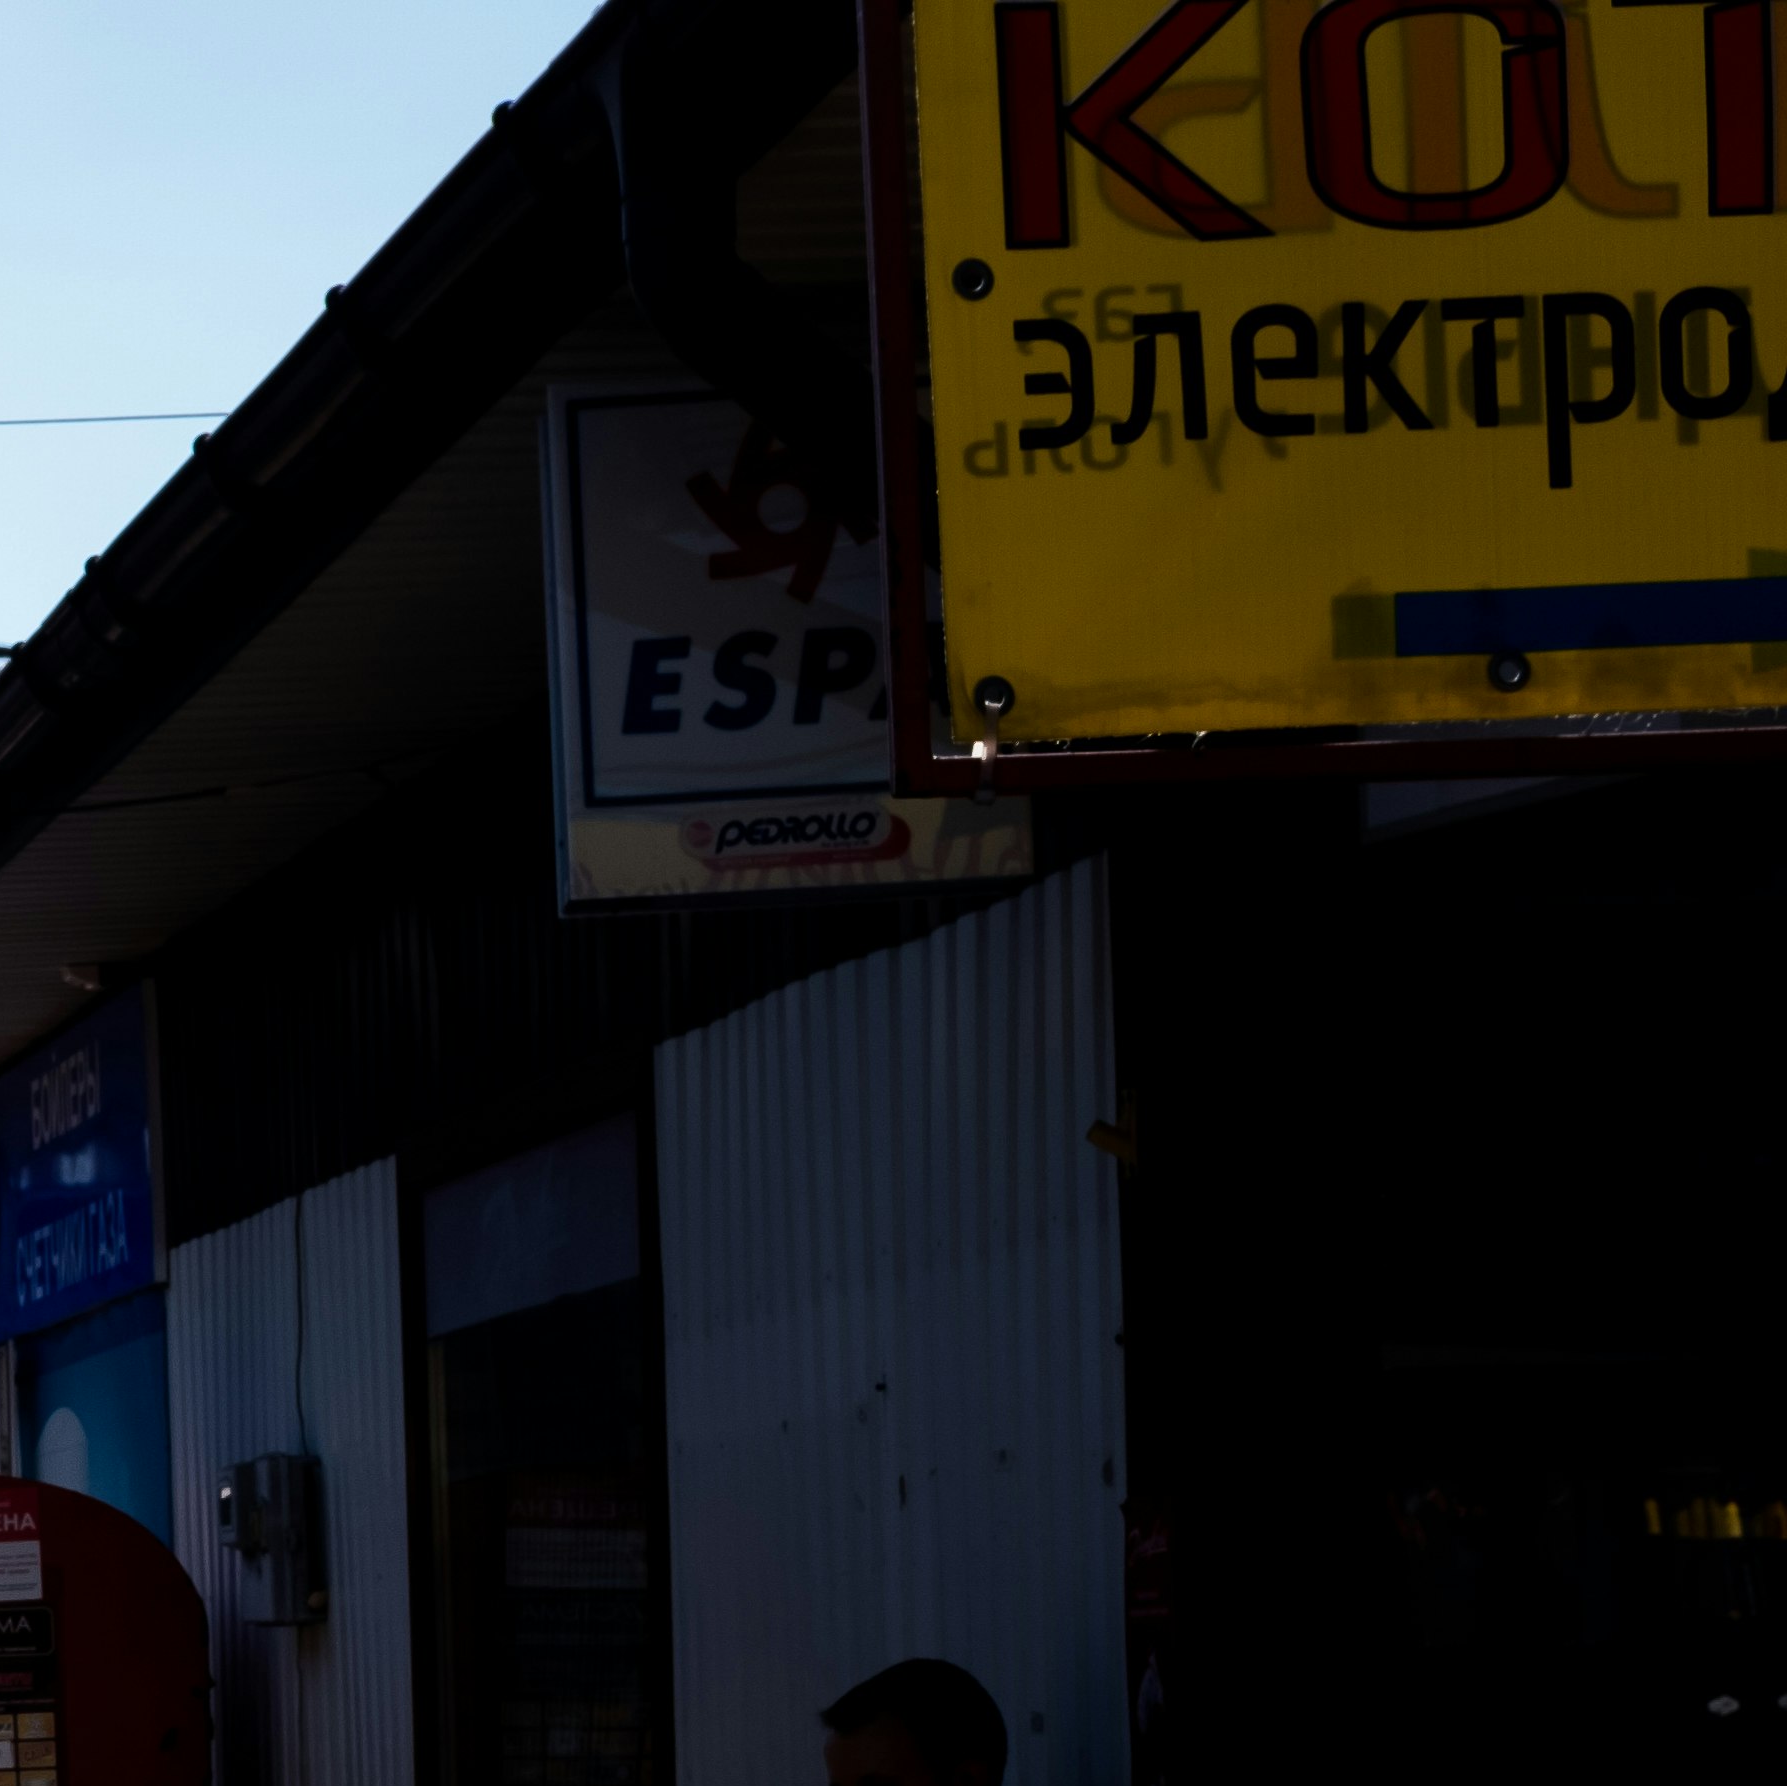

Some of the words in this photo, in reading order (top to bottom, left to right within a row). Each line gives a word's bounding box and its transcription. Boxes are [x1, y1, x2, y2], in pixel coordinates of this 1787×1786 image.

[1013, 287, 1787, 488] электро
[714, 809, 879, 854] PEDROLLO
[90, 1188, 128, 1278] ГАЗА
